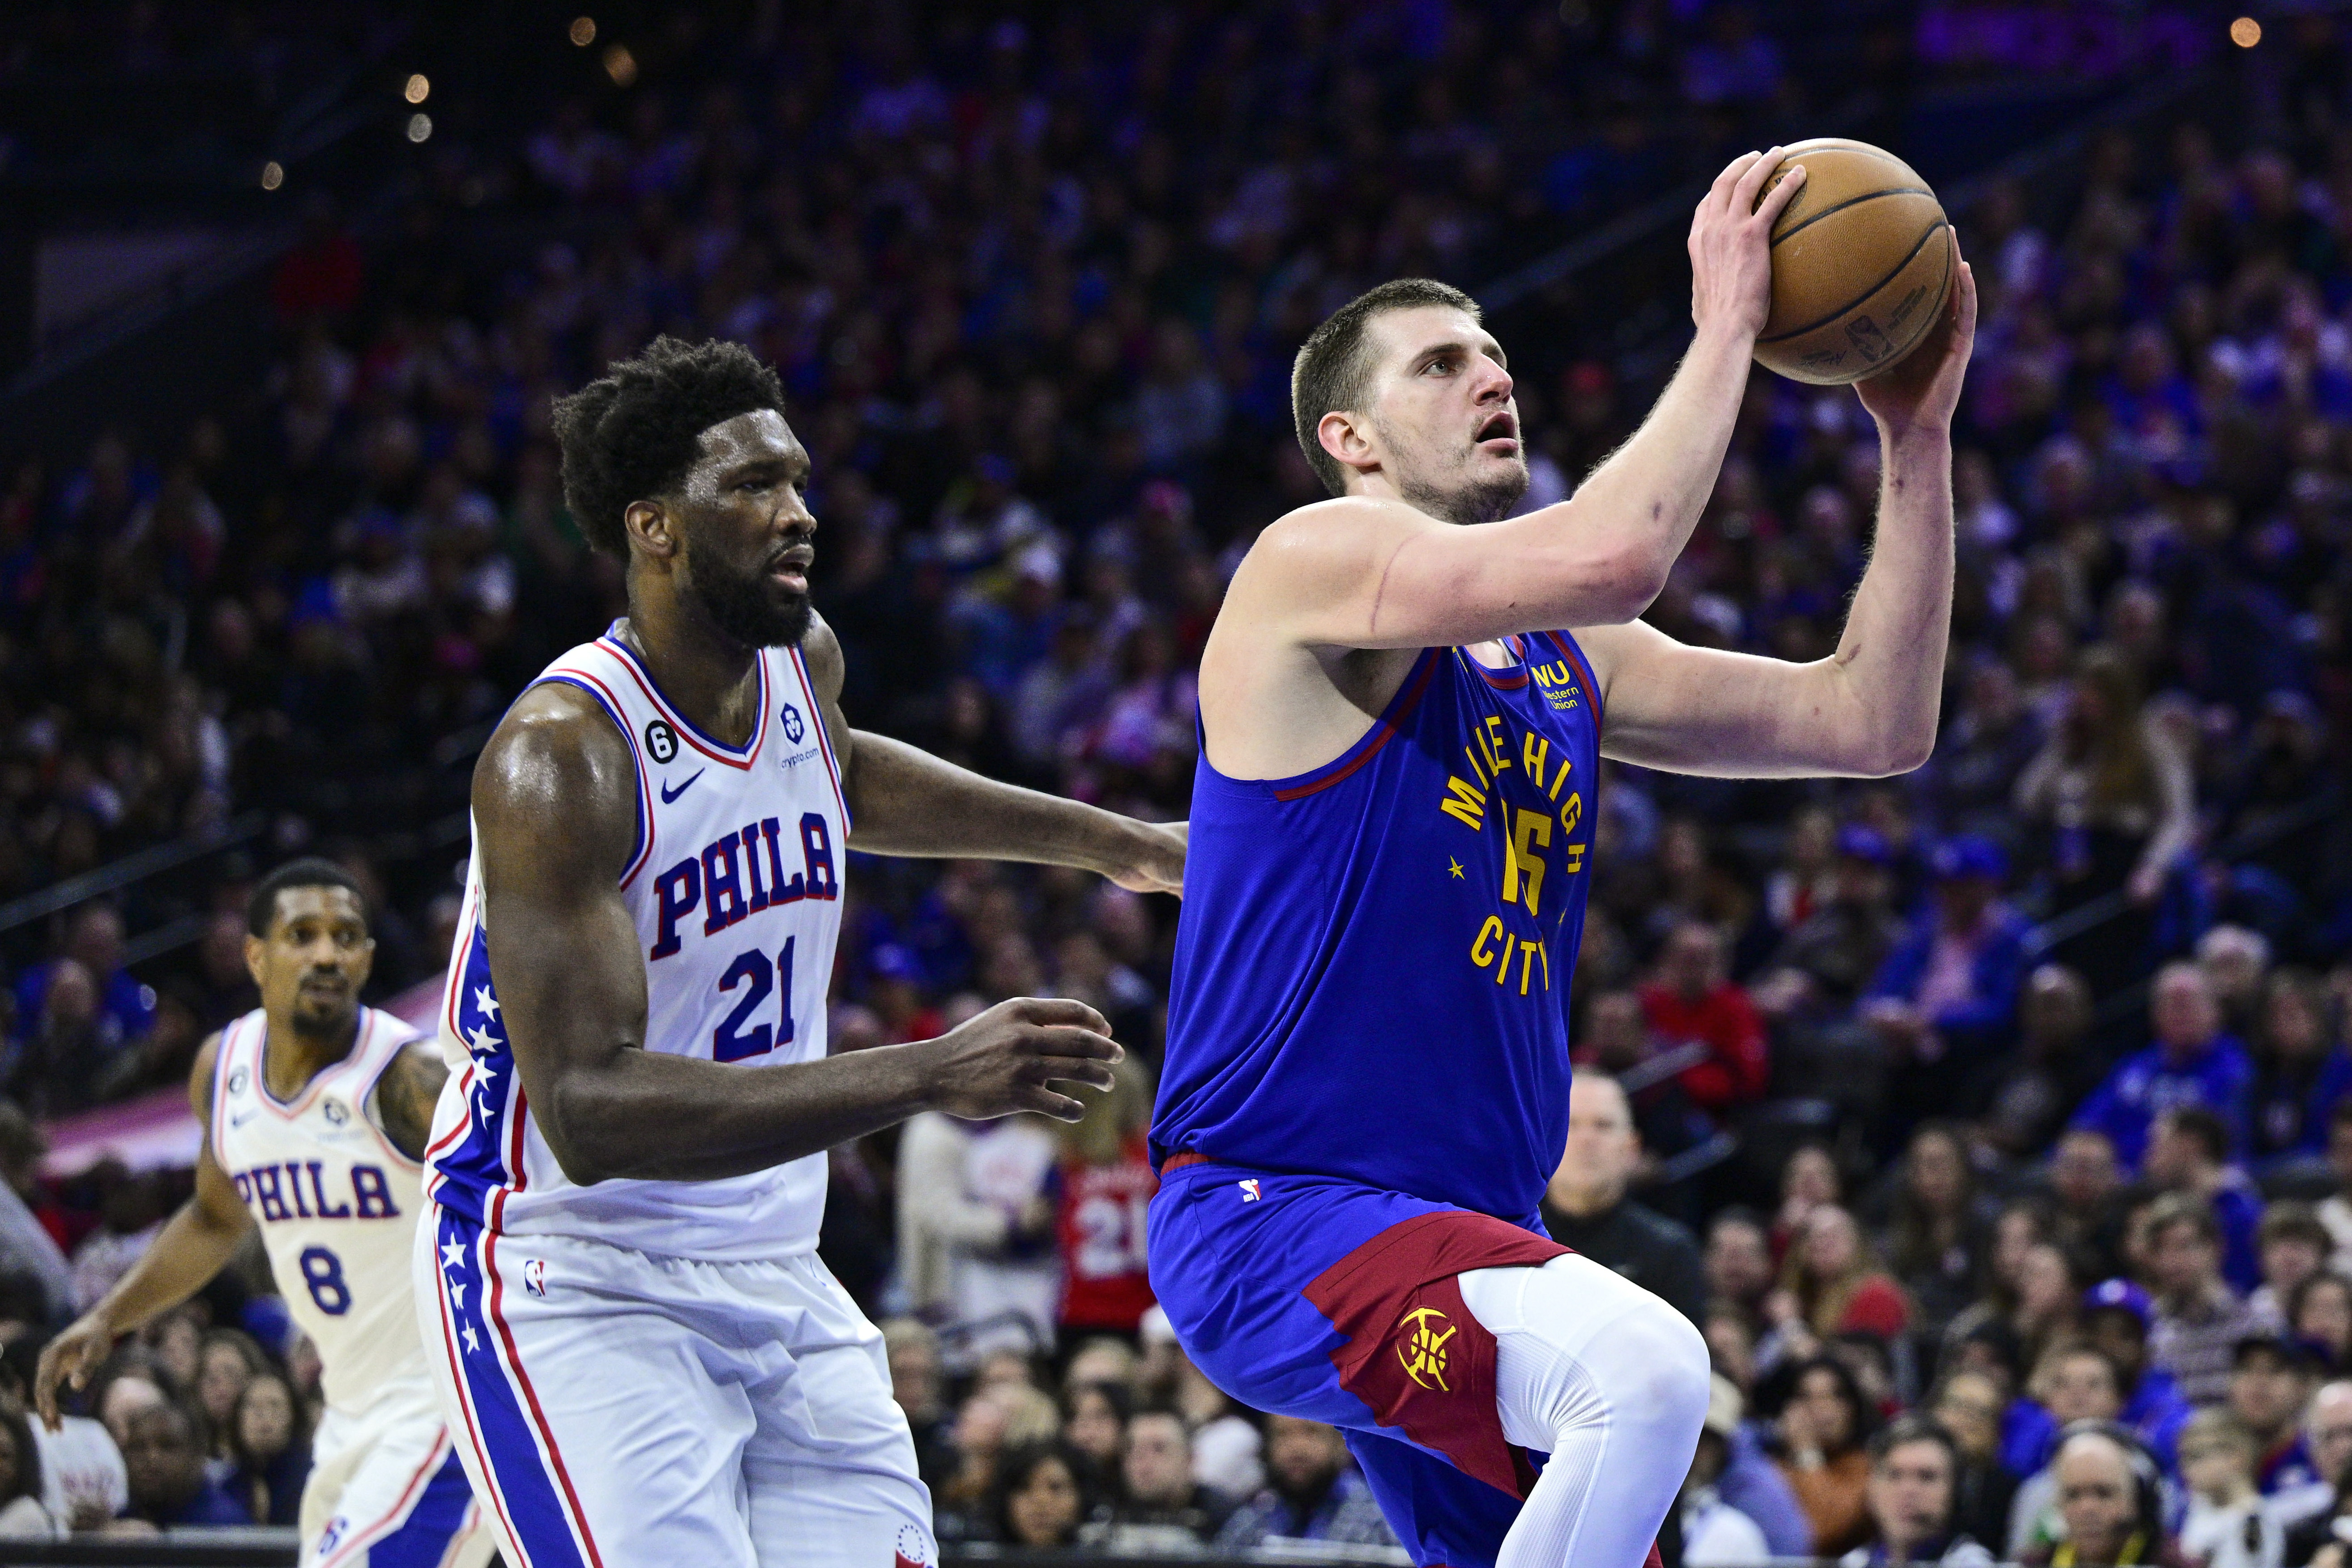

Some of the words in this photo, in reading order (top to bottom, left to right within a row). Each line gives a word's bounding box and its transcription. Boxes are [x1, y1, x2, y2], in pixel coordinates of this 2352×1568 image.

[650, 727, 674, 758] 6
[1550, 699, 1578, 710] Union
[781, 748, 820, 768] crypto.com
[1523, 731, 1586, 874] HIGH
[650, 812, 838, 961] PHILA
[1498, 796, 1553, 917] 15
[1471, 914, 1550, 995] CITY
[713, 935, 796, 1062] 21
[1242, 1192, 1255, 1203] NBA
[299, 1244, 351, 1316] 8
